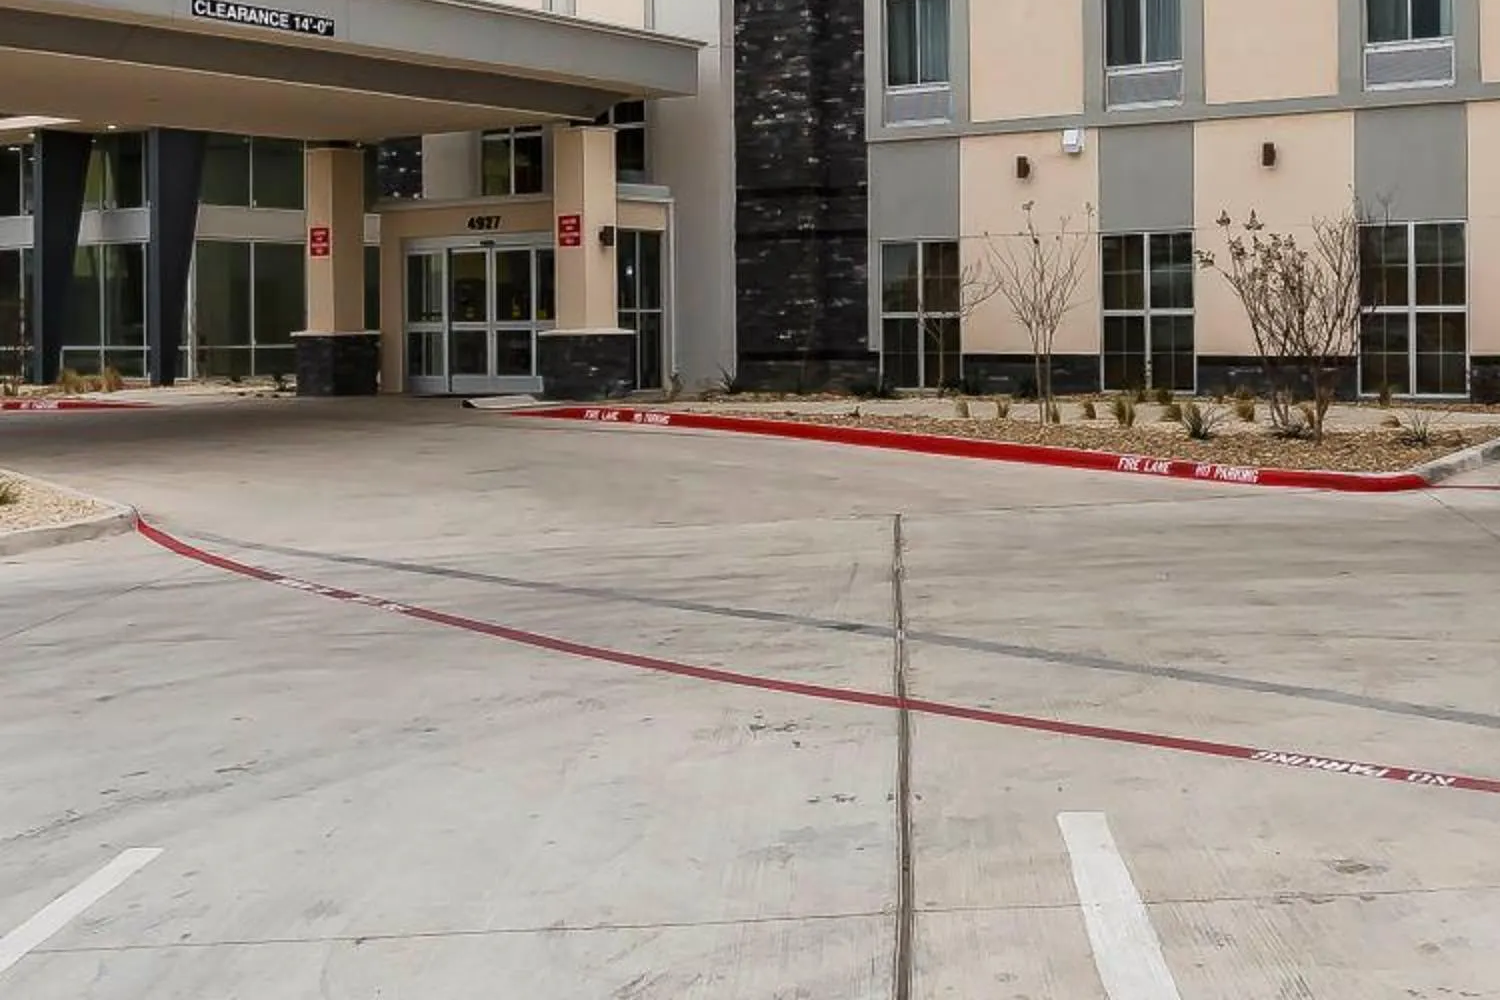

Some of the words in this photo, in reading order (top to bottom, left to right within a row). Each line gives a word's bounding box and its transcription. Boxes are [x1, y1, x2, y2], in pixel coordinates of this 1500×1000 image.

[193, 0, 290, 28] CLEARANCE
[1118, 457, 1140, 471] FIRE
[1144, 460, 1171, 475] LANE
[1195, 463, 1211, 477] NO
[1214, 465, 1259, 483] PARKING
[1252, 750, 1390, 777] PARKING
[1408, 772, 1456, 786] NO
